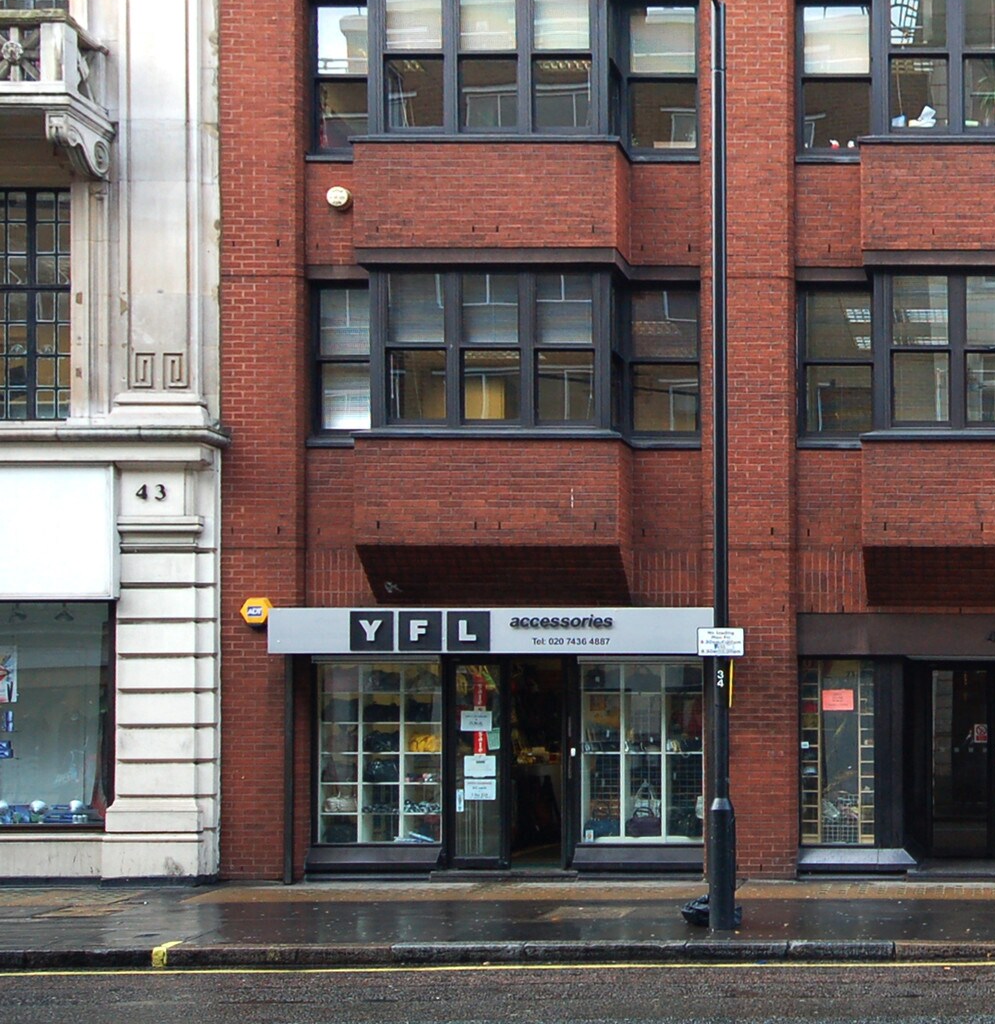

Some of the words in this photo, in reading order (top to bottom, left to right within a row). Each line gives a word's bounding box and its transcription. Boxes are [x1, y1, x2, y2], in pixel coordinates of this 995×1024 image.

[135, 483, 167, 502] 43
[247, 607, 262, 615] ADT
[509, 613, 614, 629] accessories
[548, 637, 565, 646] 020
[566, 637, 588, 646] 7436
[589, 637, 611, 646] 4887
